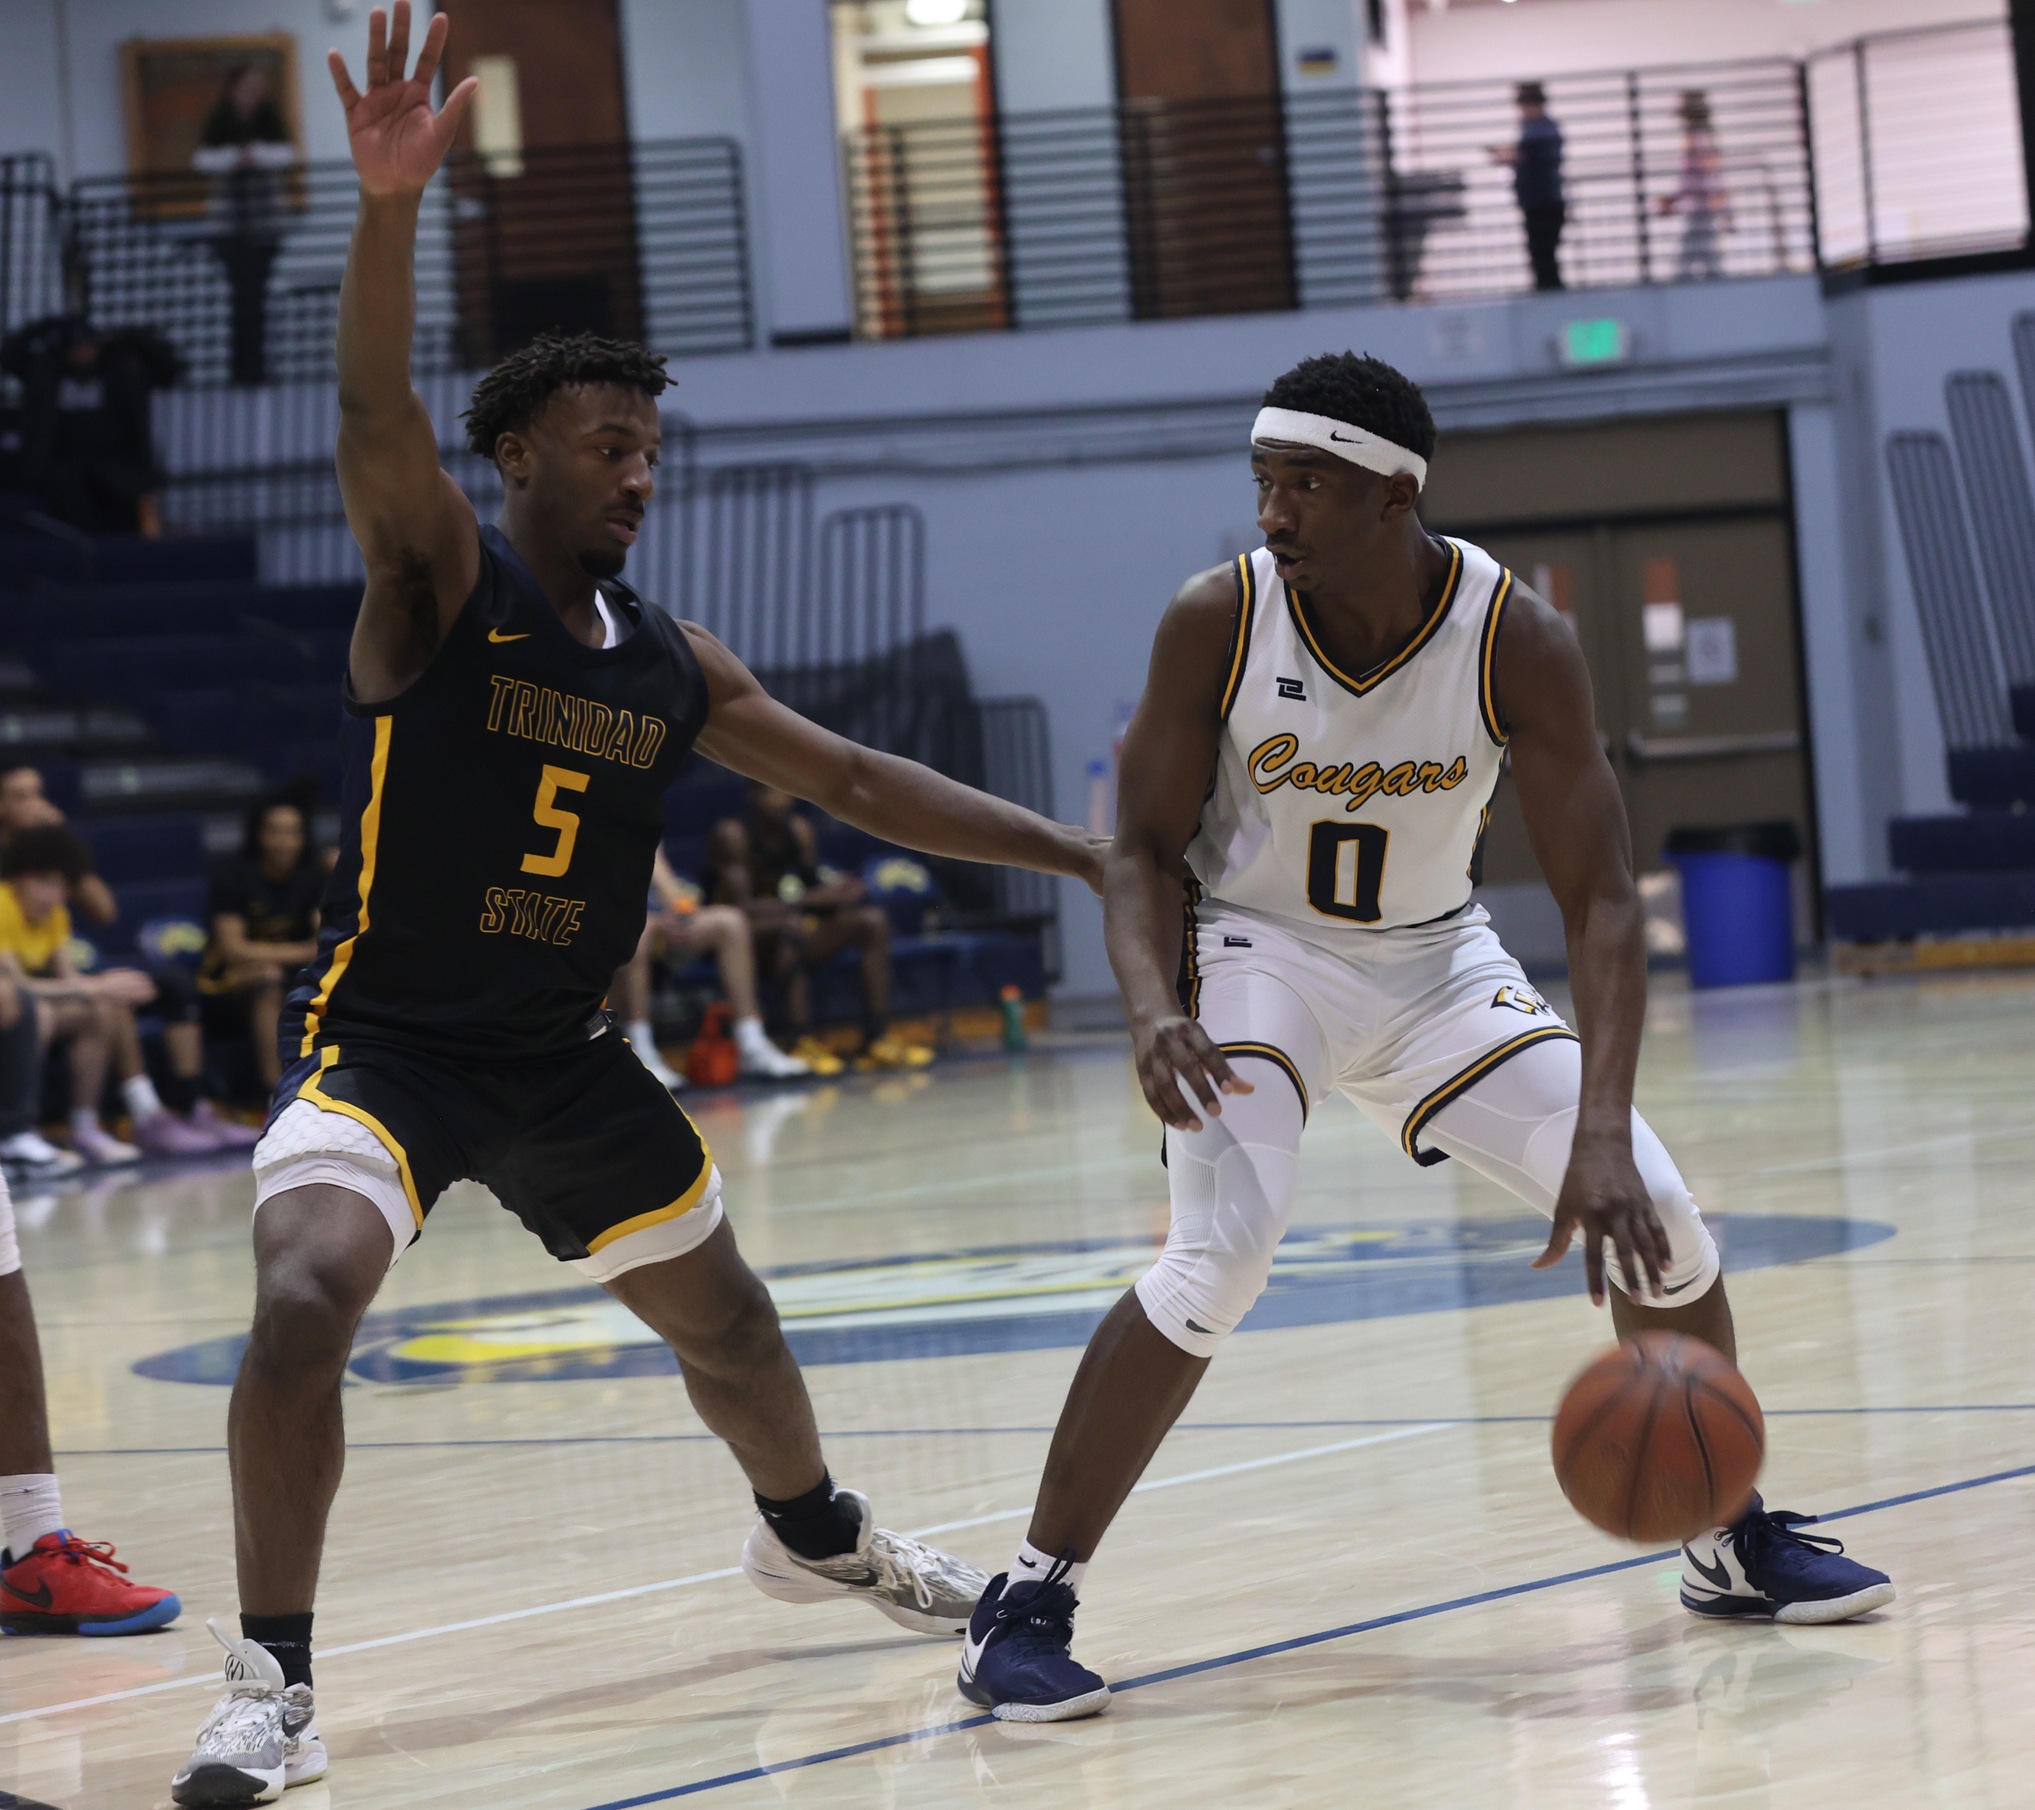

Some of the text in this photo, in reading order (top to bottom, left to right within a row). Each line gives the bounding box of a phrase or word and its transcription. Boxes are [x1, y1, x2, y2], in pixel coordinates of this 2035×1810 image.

[487, 675, 667, 769] TRINIDAD
[1248, 733, 1469, 812] Cougars
[520, 764, 591, 878] 5
[480, 887, 586, 946] STATE
[1305, 818, 1391, 925] 0
